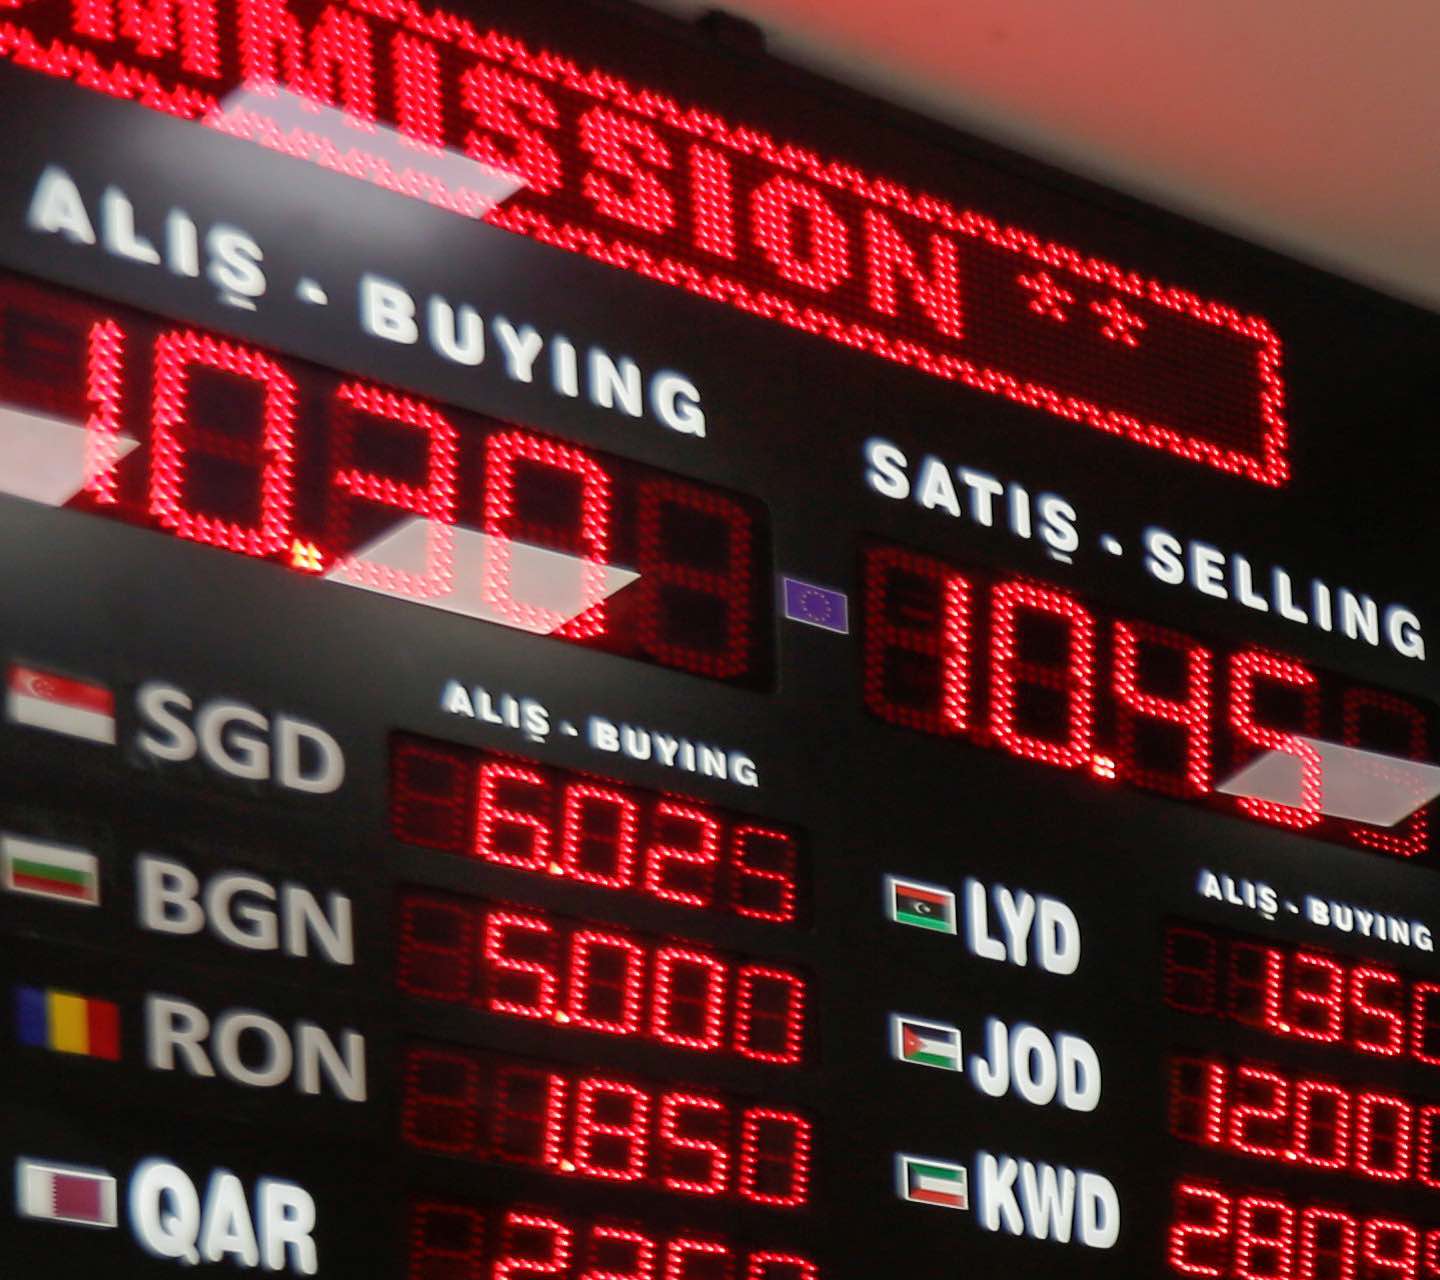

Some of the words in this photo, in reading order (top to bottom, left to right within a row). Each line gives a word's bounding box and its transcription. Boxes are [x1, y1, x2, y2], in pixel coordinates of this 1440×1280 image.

[30, 165, 268, 311] ALIŞ
[360, 274, 707, 438] BUYING
[866, 440, 1080, 564] SATIŞ
[1144, 526, 1427, 661] SELLING
[137, 683, 346, 795] SGD
[444, 681, 550, 742] ALIŞ
[596, 716, 761, 788] BUYING
[137, 857, 354, 966] BGN
[966, 878, 1081, 975] LYD
[1200, 871, 1278, 920] ALIŞ
[1308, 899, 1434, 952] BUYING
[146, 995, 367, 1103] RON
[972, 1019, 1101, 1112] JOD
[130, 1158, 319, 1276] QAR
[975, 1153, 1121, 1250] KWD
